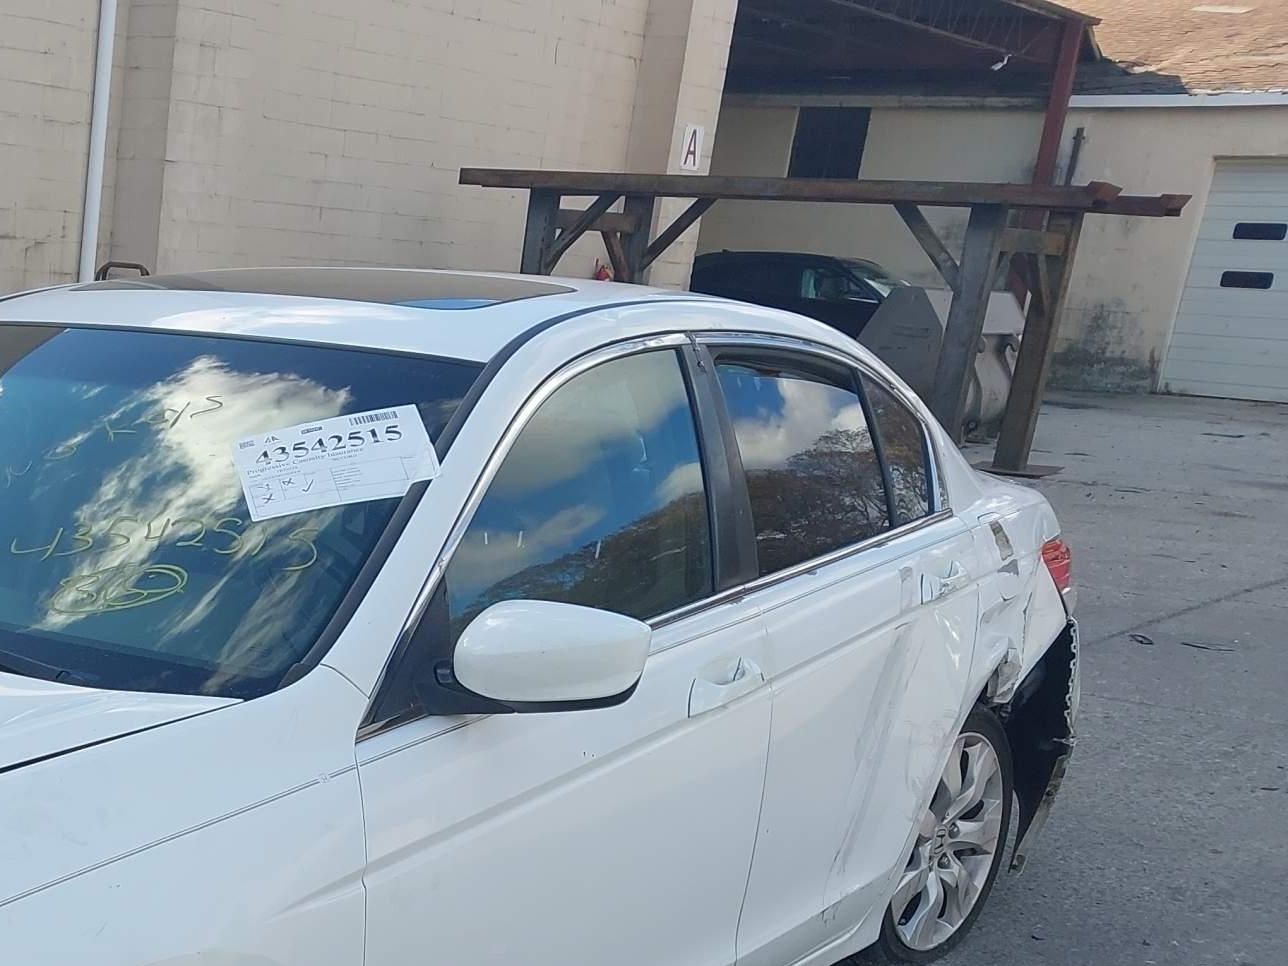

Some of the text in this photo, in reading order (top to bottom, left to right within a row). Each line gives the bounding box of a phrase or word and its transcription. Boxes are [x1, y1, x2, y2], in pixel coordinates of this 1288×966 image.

[684, 129, 697, 167] A
[256, 424, 403, 465] 43542515
[10, 517, 320, 571] 43542515
